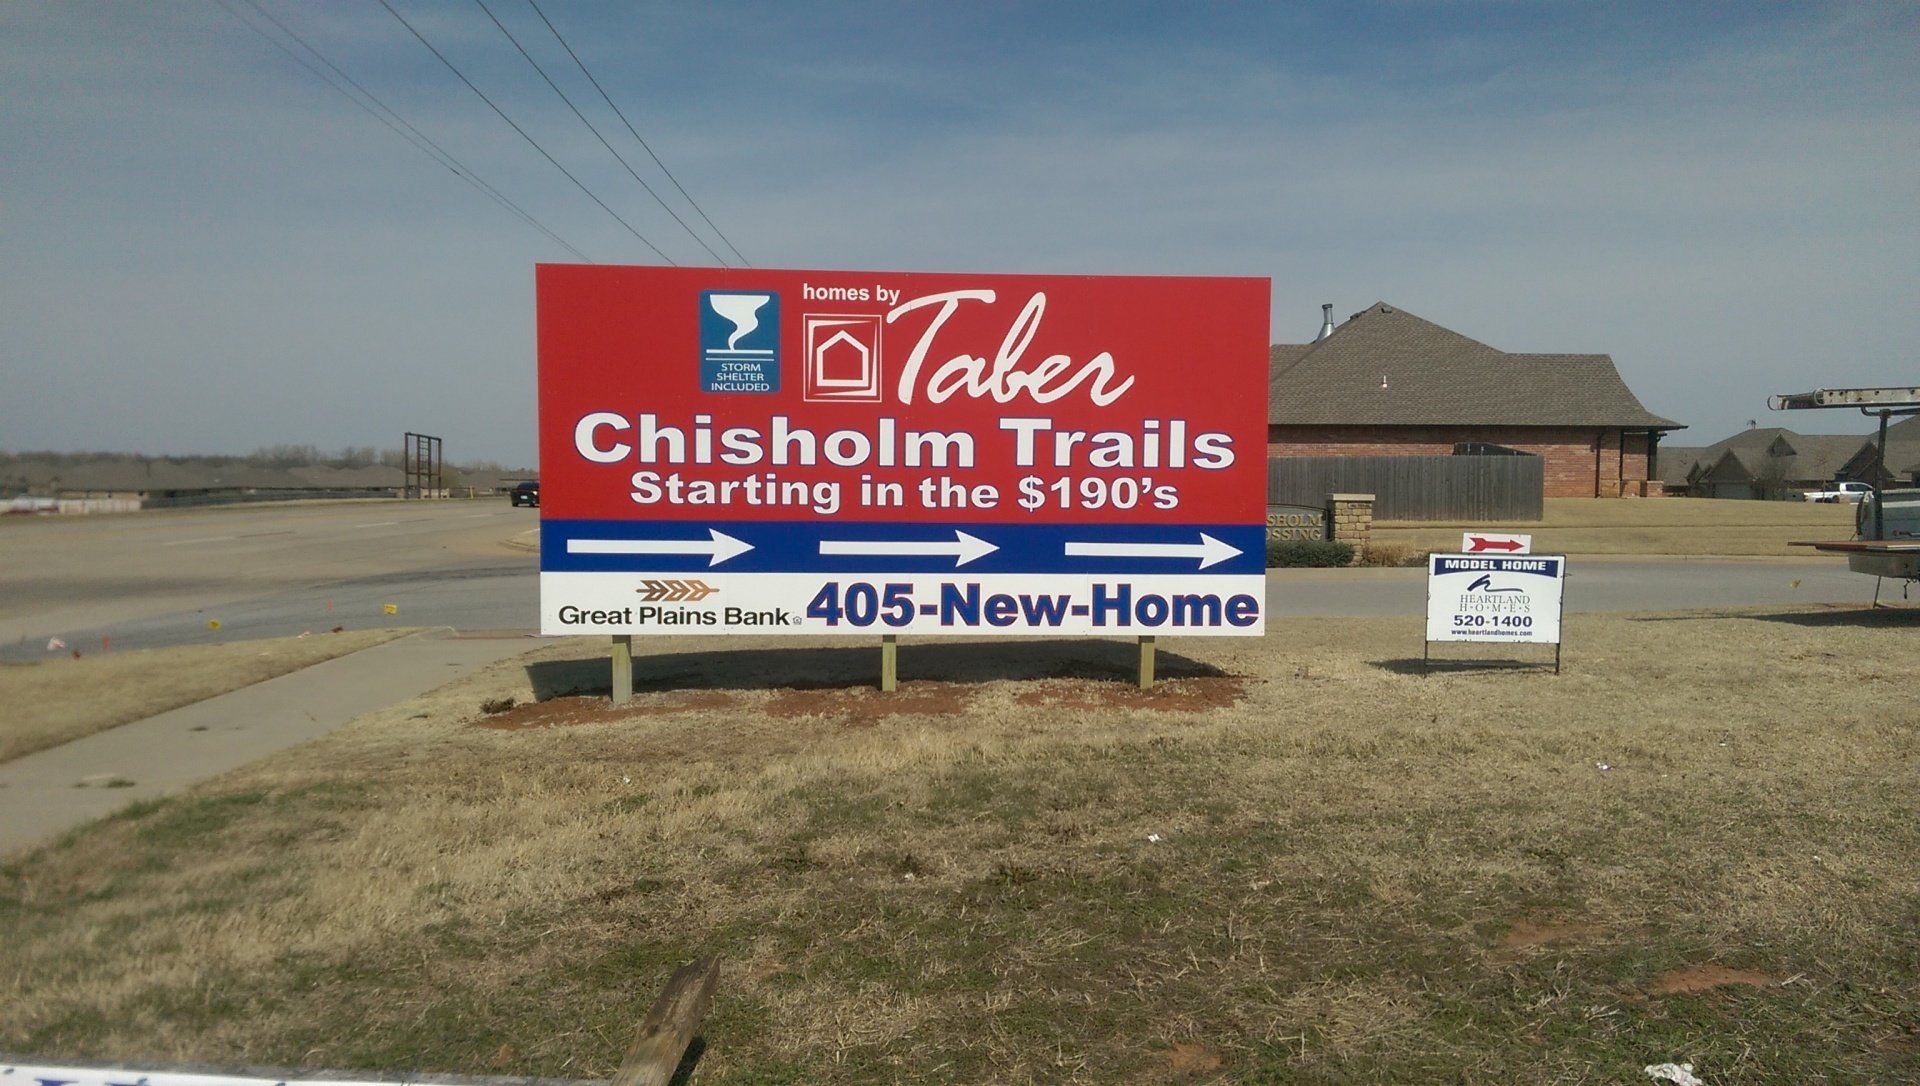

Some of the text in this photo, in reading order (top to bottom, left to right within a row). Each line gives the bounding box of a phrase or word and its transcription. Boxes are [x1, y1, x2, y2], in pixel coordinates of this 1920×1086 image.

[803, 283, 900, 306] homes by
[886, 289, 1135, 407] Taber
[721, 363, 761, 372] STORM
[716, 372, 765, 382] SHELTER
[711, 382, 770, 392] INCLUDED
[573, 411, 1236, 469] Chisholm Trails
[630, 471, 1179, 515] Starting in the $190's
[1445, 559, 1547, 571] MODEL HOME
[806, 581, 1260, 628] 405-New-Home
[1460, 594, 1531, 604] HEARTLAND
[558, 605, 790, 626] Great Plains Bank
[1453, 614, 1533, 627] 520-1400
[1450, 628, 1533, 637] www.heartlandhomes.com
